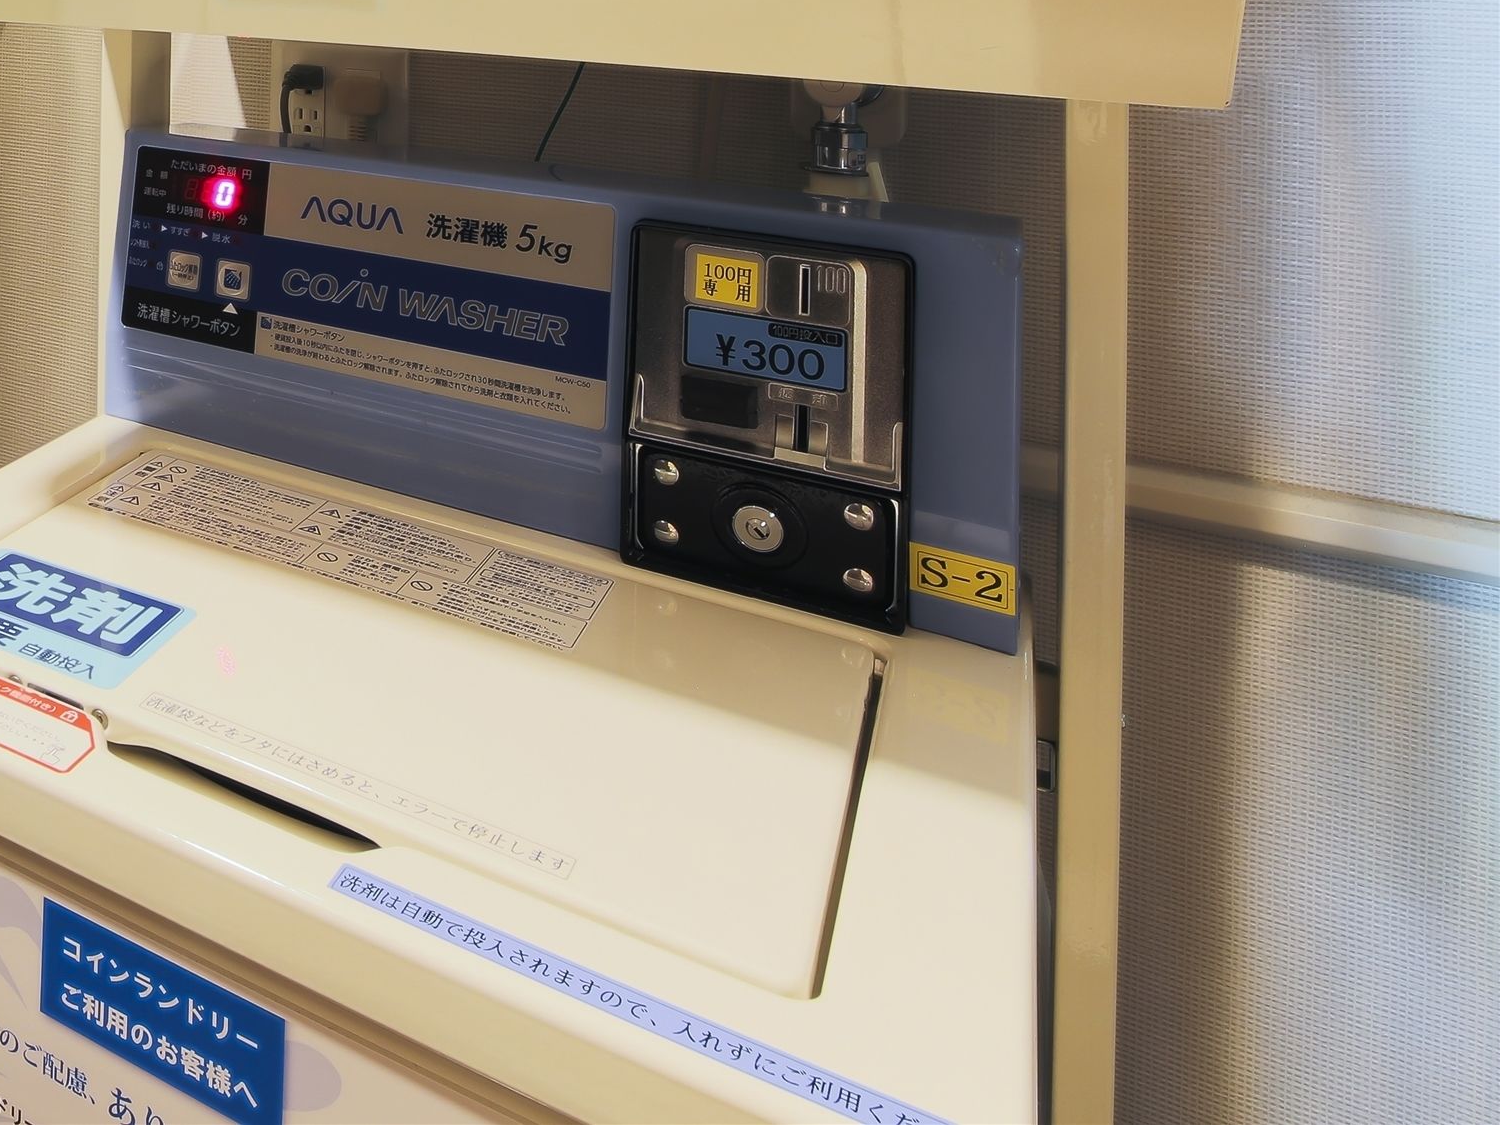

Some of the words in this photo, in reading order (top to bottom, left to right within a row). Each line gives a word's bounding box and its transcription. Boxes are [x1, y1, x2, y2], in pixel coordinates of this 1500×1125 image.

[170, 158, 237, 178] ただいまの金額
[241, 169, 253, 181] 円
[214, 180, 236, 207] 0
[170, 226, 191, 237] すすぎ
[211, 232, 231, 244] 脱水
[237, 214, 249, 227] 分
[300, 195, 404, 235] AQUA
[425, 212, 509, 250] 洗濯機
[514, 223, 574, 266] 5kg
[703, 262, 752, 285] 100円
[816, 264, 847, 296] 100
[702, 278, 751, 303] 専用
[136, 302, 242, 338] 洗濯槽シャワーボタン
[273, 320, 346, 343] 洗濯槽シャワーボタン
[398, 288, 570, 348] WASHER
[715, 333, 825, 381] ¥300
[554, 374, 592, 390] MCW-C50
[919, 556, 1004, 604] S-2
[18, 642, 96, 681] 自動投入
[62, 935, 259, 1050] コインランドリー
[59, 982, 259, 1109] ご利用のお客様へ
